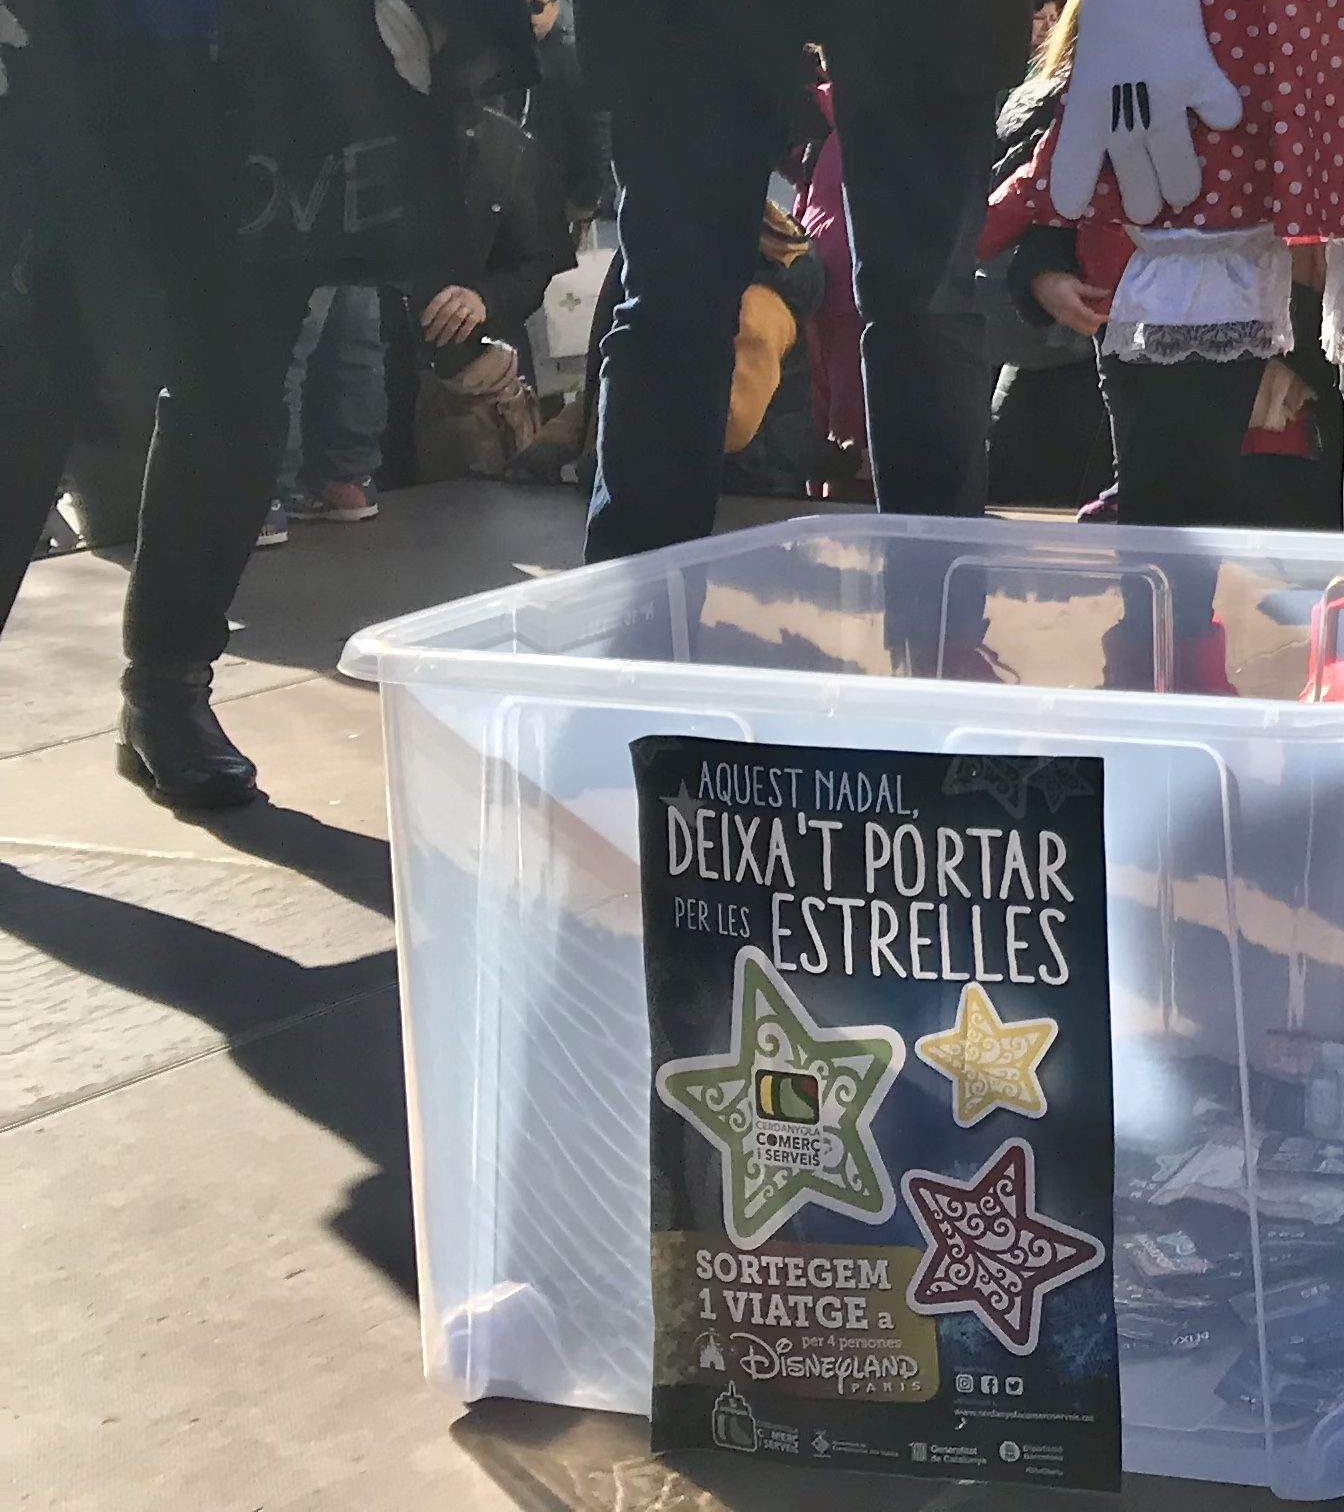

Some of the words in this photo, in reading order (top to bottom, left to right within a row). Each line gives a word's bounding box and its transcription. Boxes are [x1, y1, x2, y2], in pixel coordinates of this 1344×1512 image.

[699, 760, 804, 808] AQUEST
[815, 769, 920, 820] NADAL,
[667, 805, 843, 891] DEIXA'T
[865, 821, 1076, 903] PORTAR
[673, 896, 714, 934] PER
[717, 903, 752, 941] LES
[771, 892, 1070, 986] ESTRELLES
[765, 1148, 821, 1167] SERVEIS
[697, 1249, 892, 1290] SORTEGEM
[699, 1288, 717, 1321] 1
[722, 1289, 870, 1330] VIATGE
[877, 1311, 896, 1330] a
[802, 1336, 824, 1350] per
[826, 1336, 836, 1348] 4
